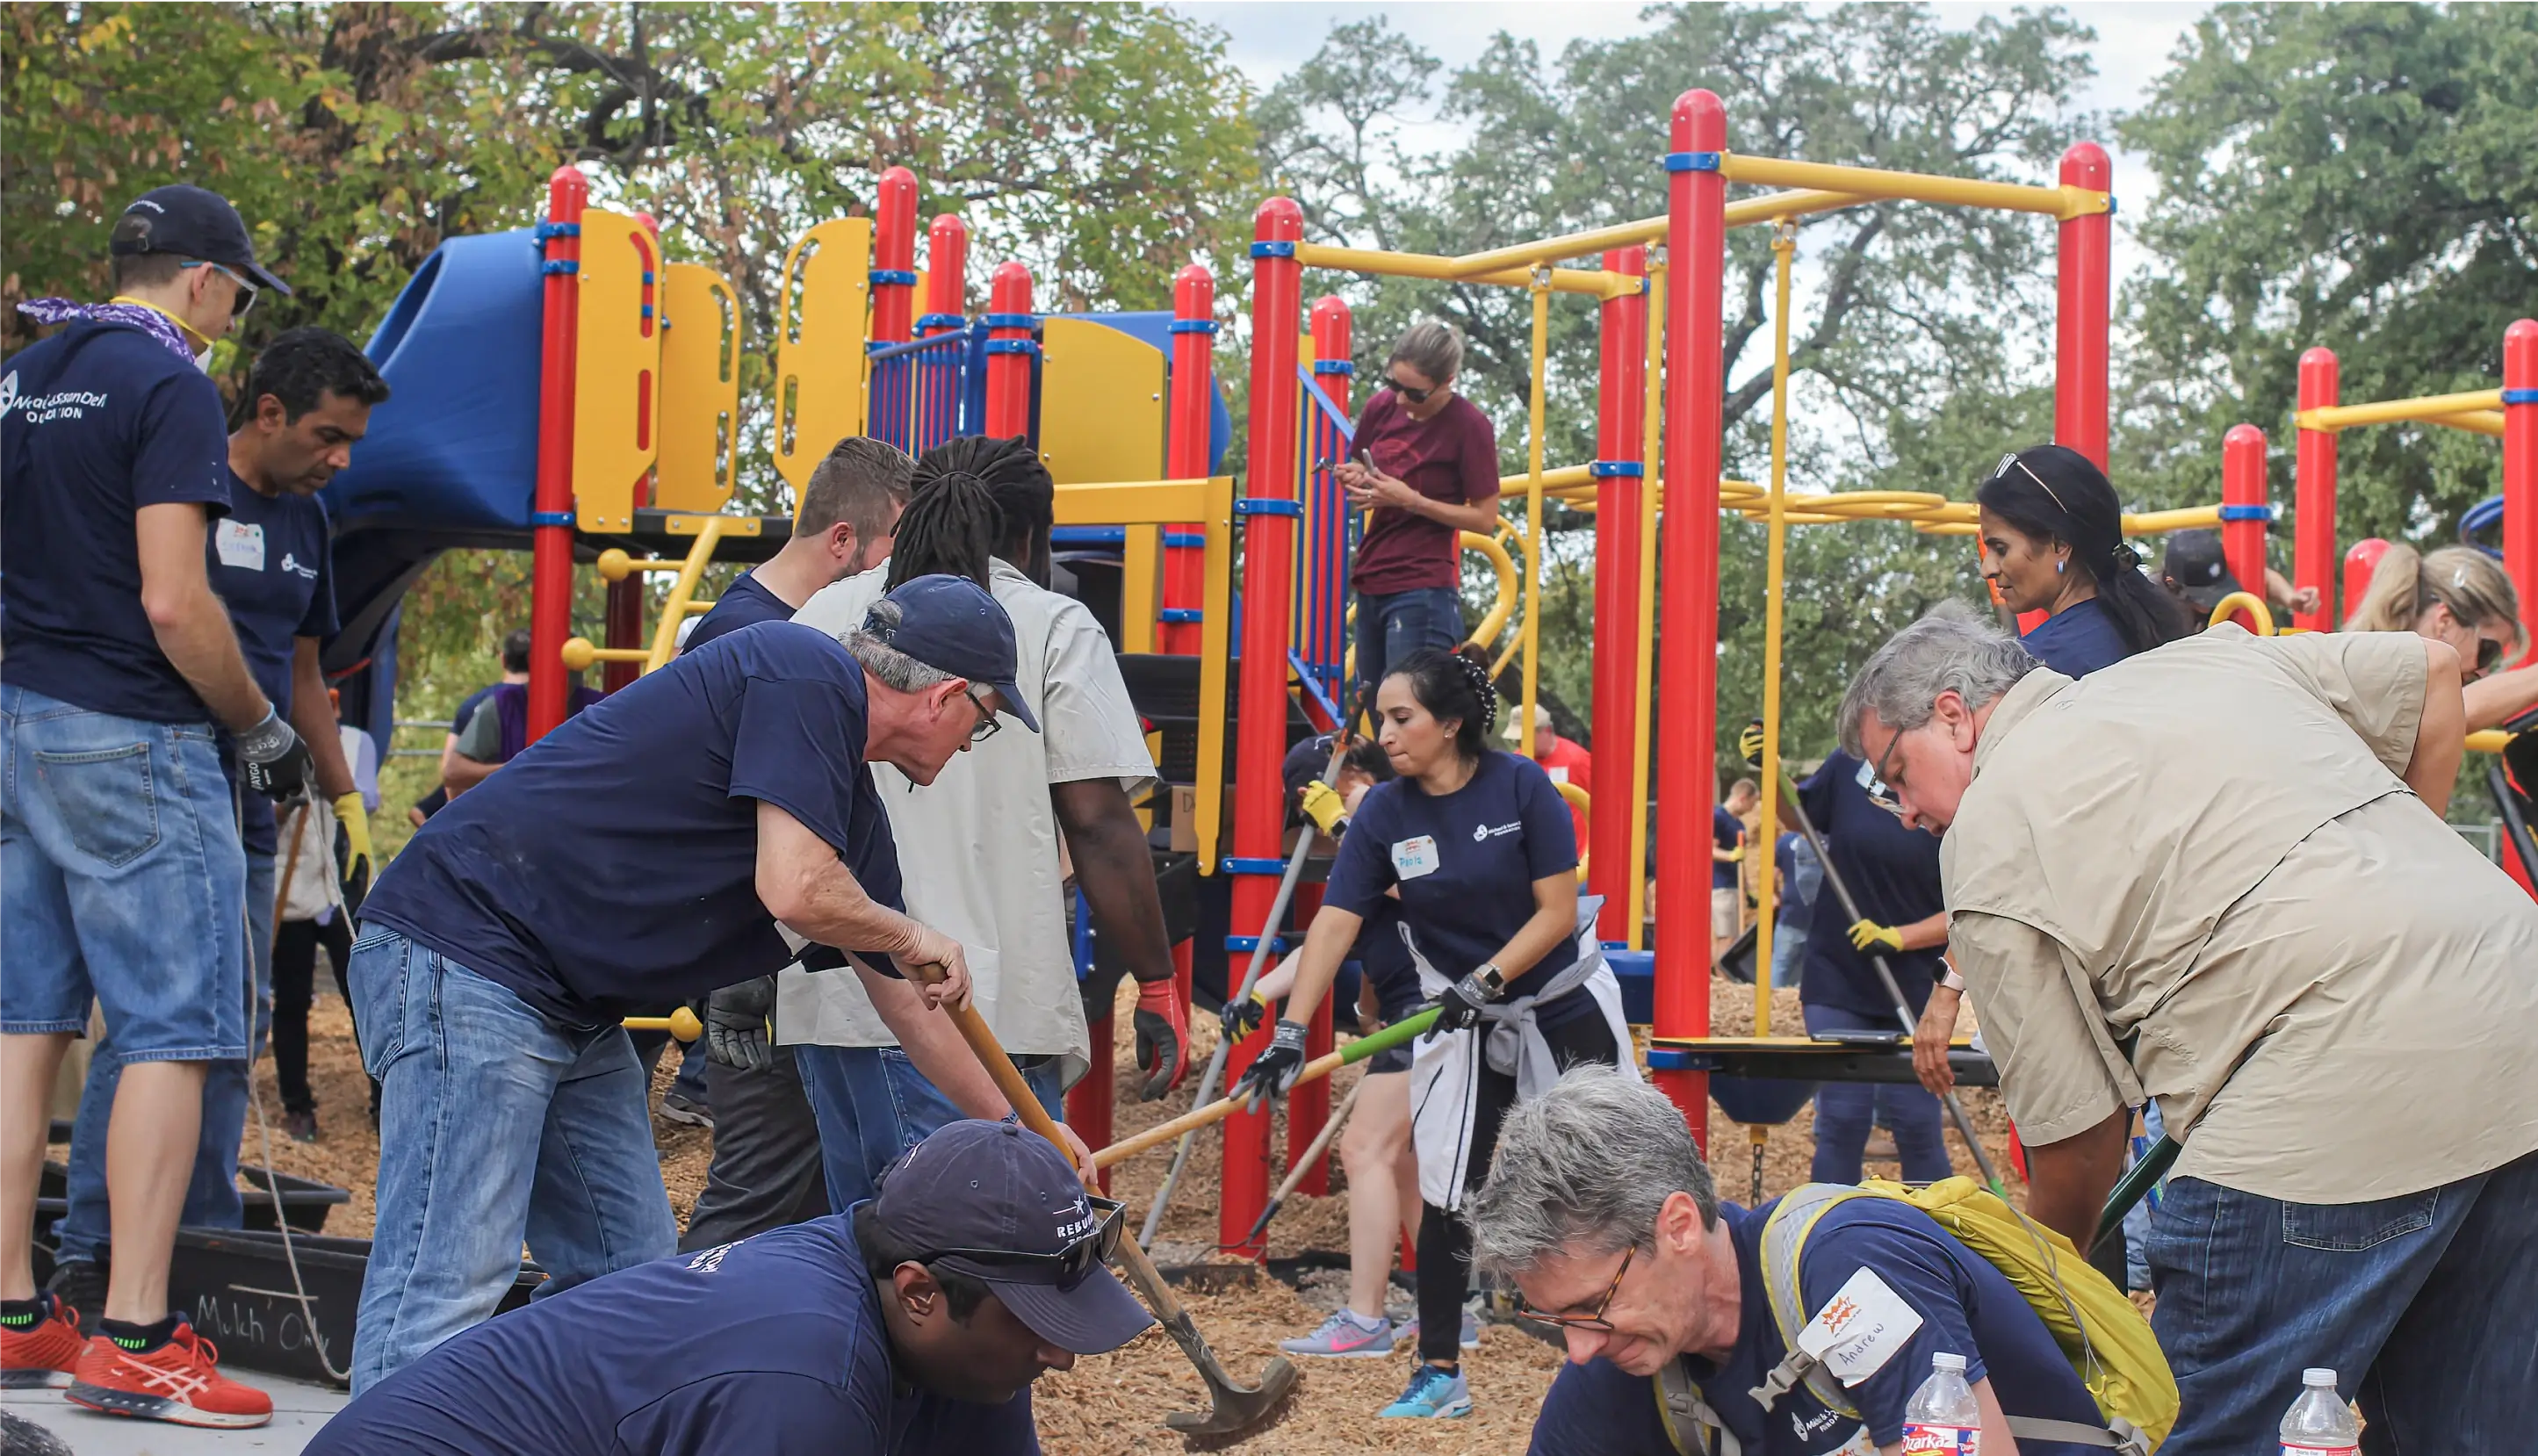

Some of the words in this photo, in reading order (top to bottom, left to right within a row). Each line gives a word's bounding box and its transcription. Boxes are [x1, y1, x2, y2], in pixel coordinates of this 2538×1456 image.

[80, 391, 107, 407] Dell
[195, 1294, 265, 1344] Mulch
[1838, 1323, 1885, 1366] Andrew
